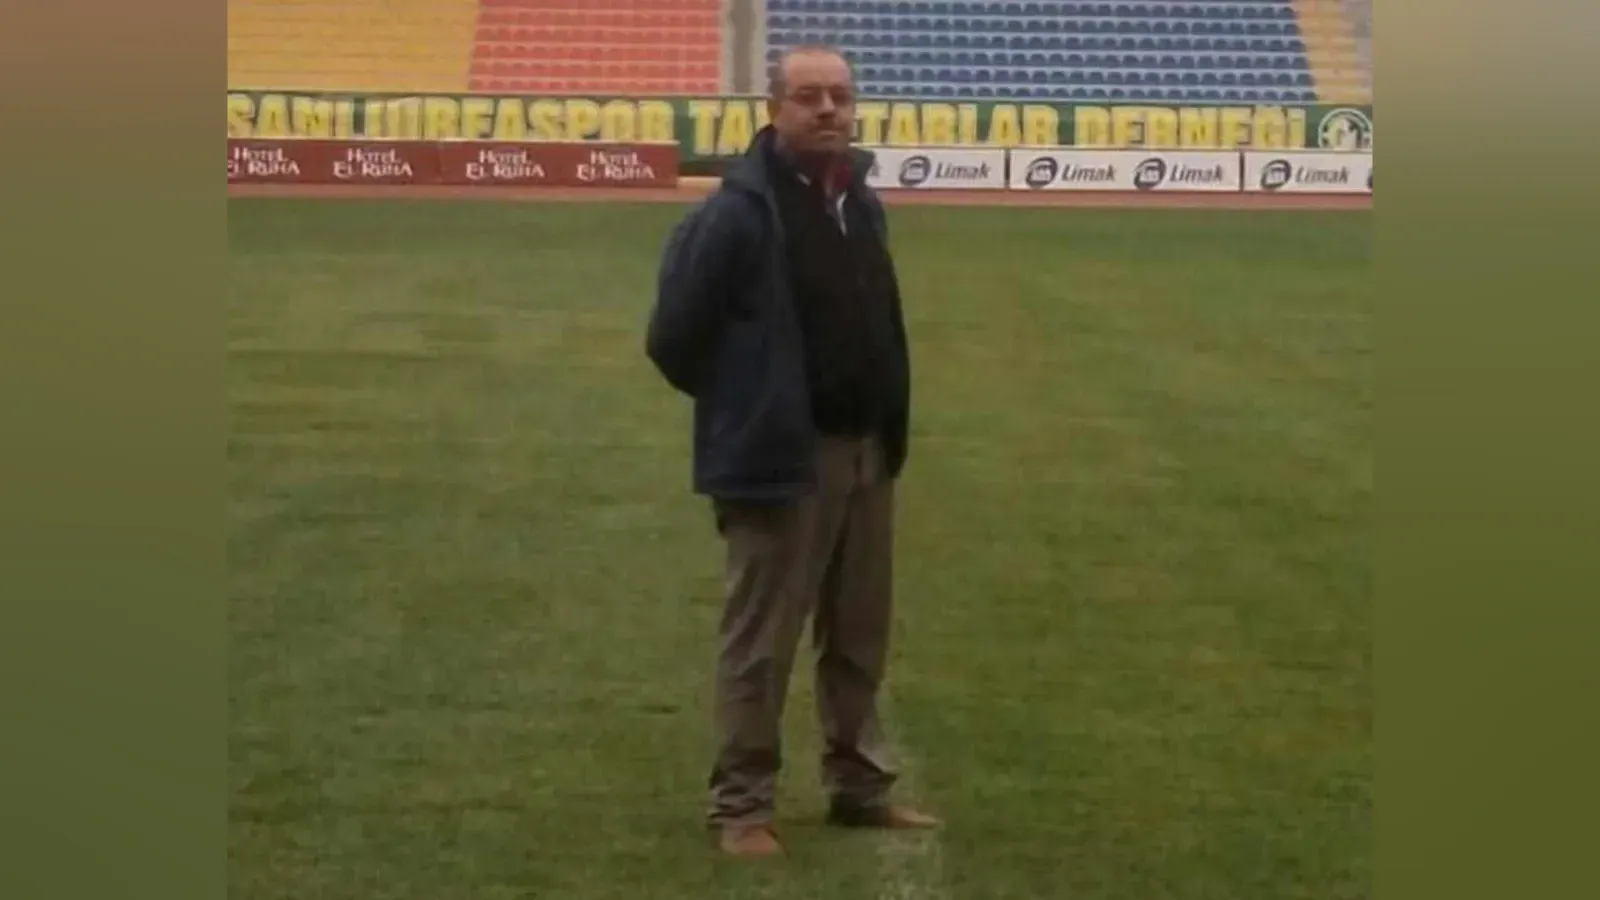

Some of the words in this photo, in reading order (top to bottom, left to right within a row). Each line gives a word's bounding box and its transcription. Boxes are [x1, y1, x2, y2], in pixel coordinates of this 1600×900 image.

[935, 161, 991, 180] Limak
[1061, 163, 1117, 183] Limak
[1170, 163, 1224, 184] Limak
[1295, 165, 1350, 185] Limak
